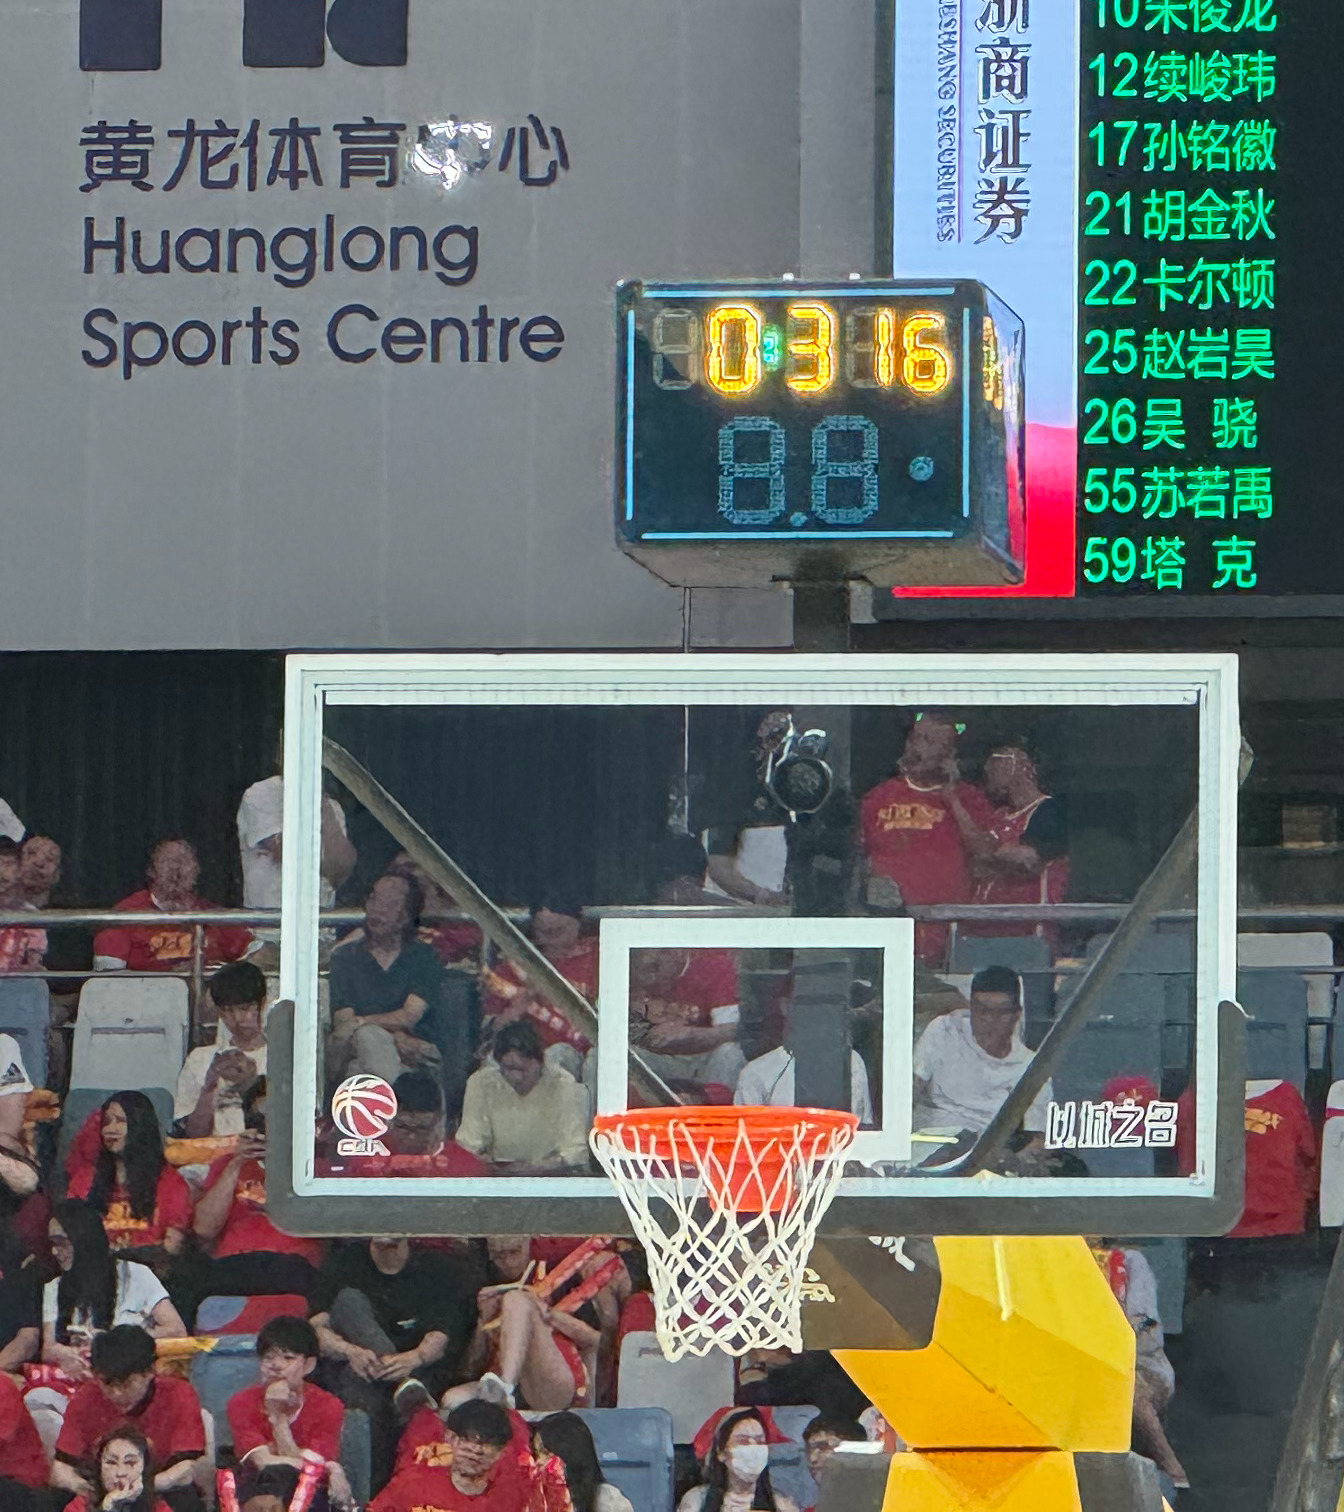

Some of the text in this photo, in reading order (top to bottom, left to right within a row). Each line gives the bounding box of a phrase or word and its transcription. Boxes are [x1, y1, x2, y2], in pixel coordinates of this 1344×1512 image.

[1144, 50, 1276, 102] 续峻玮
[79, 113, 570, 192] 黄龙体育心
[1143, 119, 1276, 172] 孙铭徽
[1142, 188, 1275, 241] 胡金秋
[82, 213, 480, 288] Huanglong
[1143, 257, 1275, 311] 卡尔顿
[81, 303, 565, 380] Sports Centre
[1142, 327, 1275, 380] 赵岩昊
[1141, 466, 1272, 519] 苏若禹
